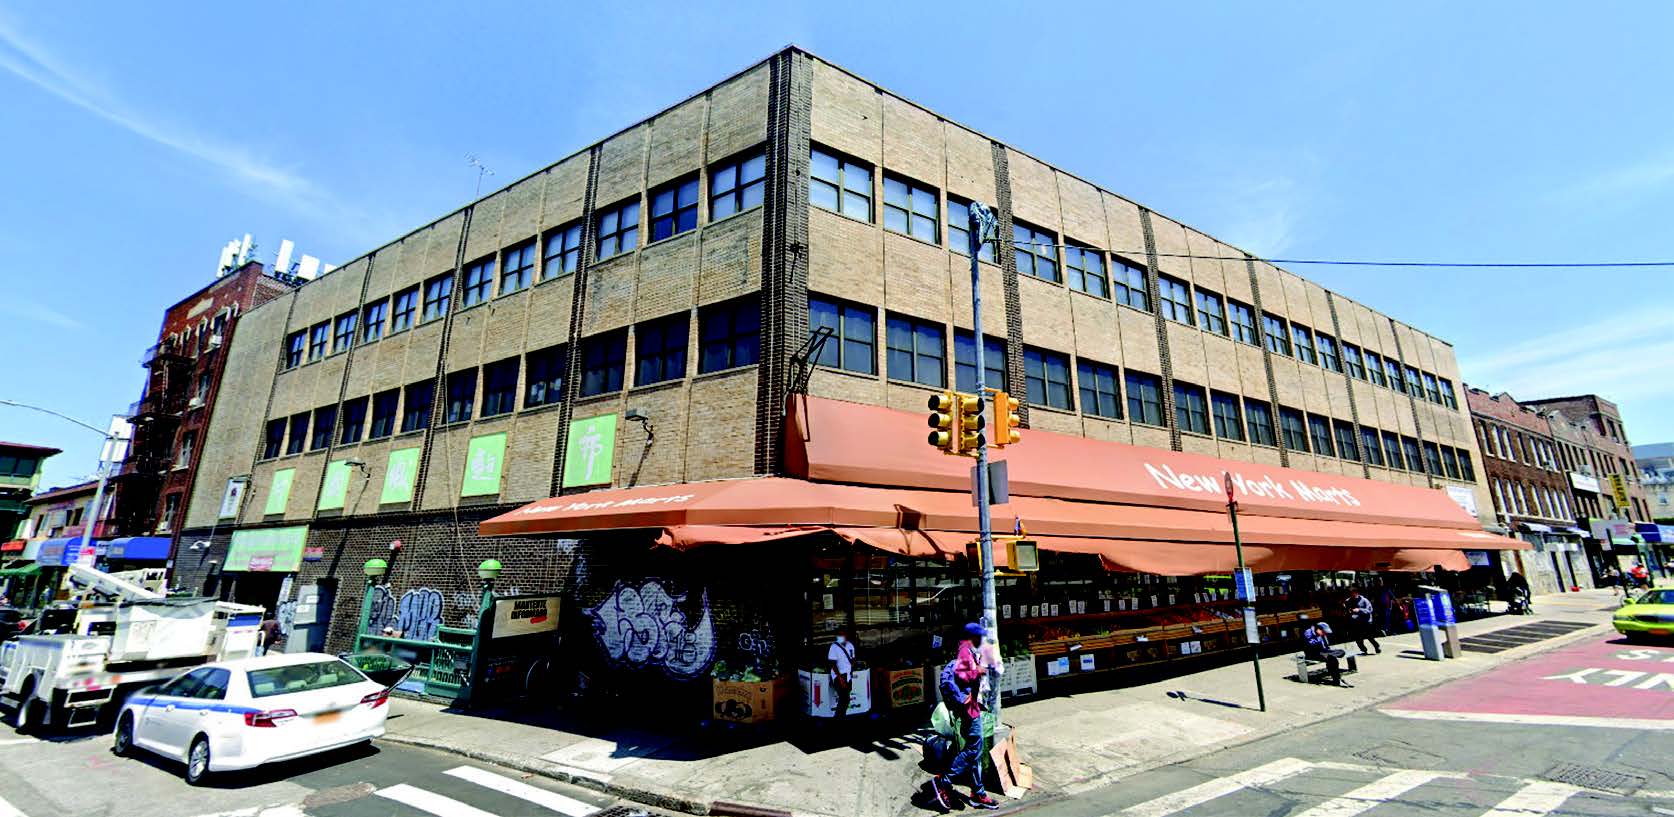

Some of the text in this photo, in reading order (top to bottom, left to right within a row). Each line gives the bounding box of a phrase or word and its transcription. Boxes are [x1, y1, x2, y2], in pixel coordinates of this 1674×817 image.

[1144, 463, 1361, 507] New York Marts
[514, 494, 695, 515] New York Marts
